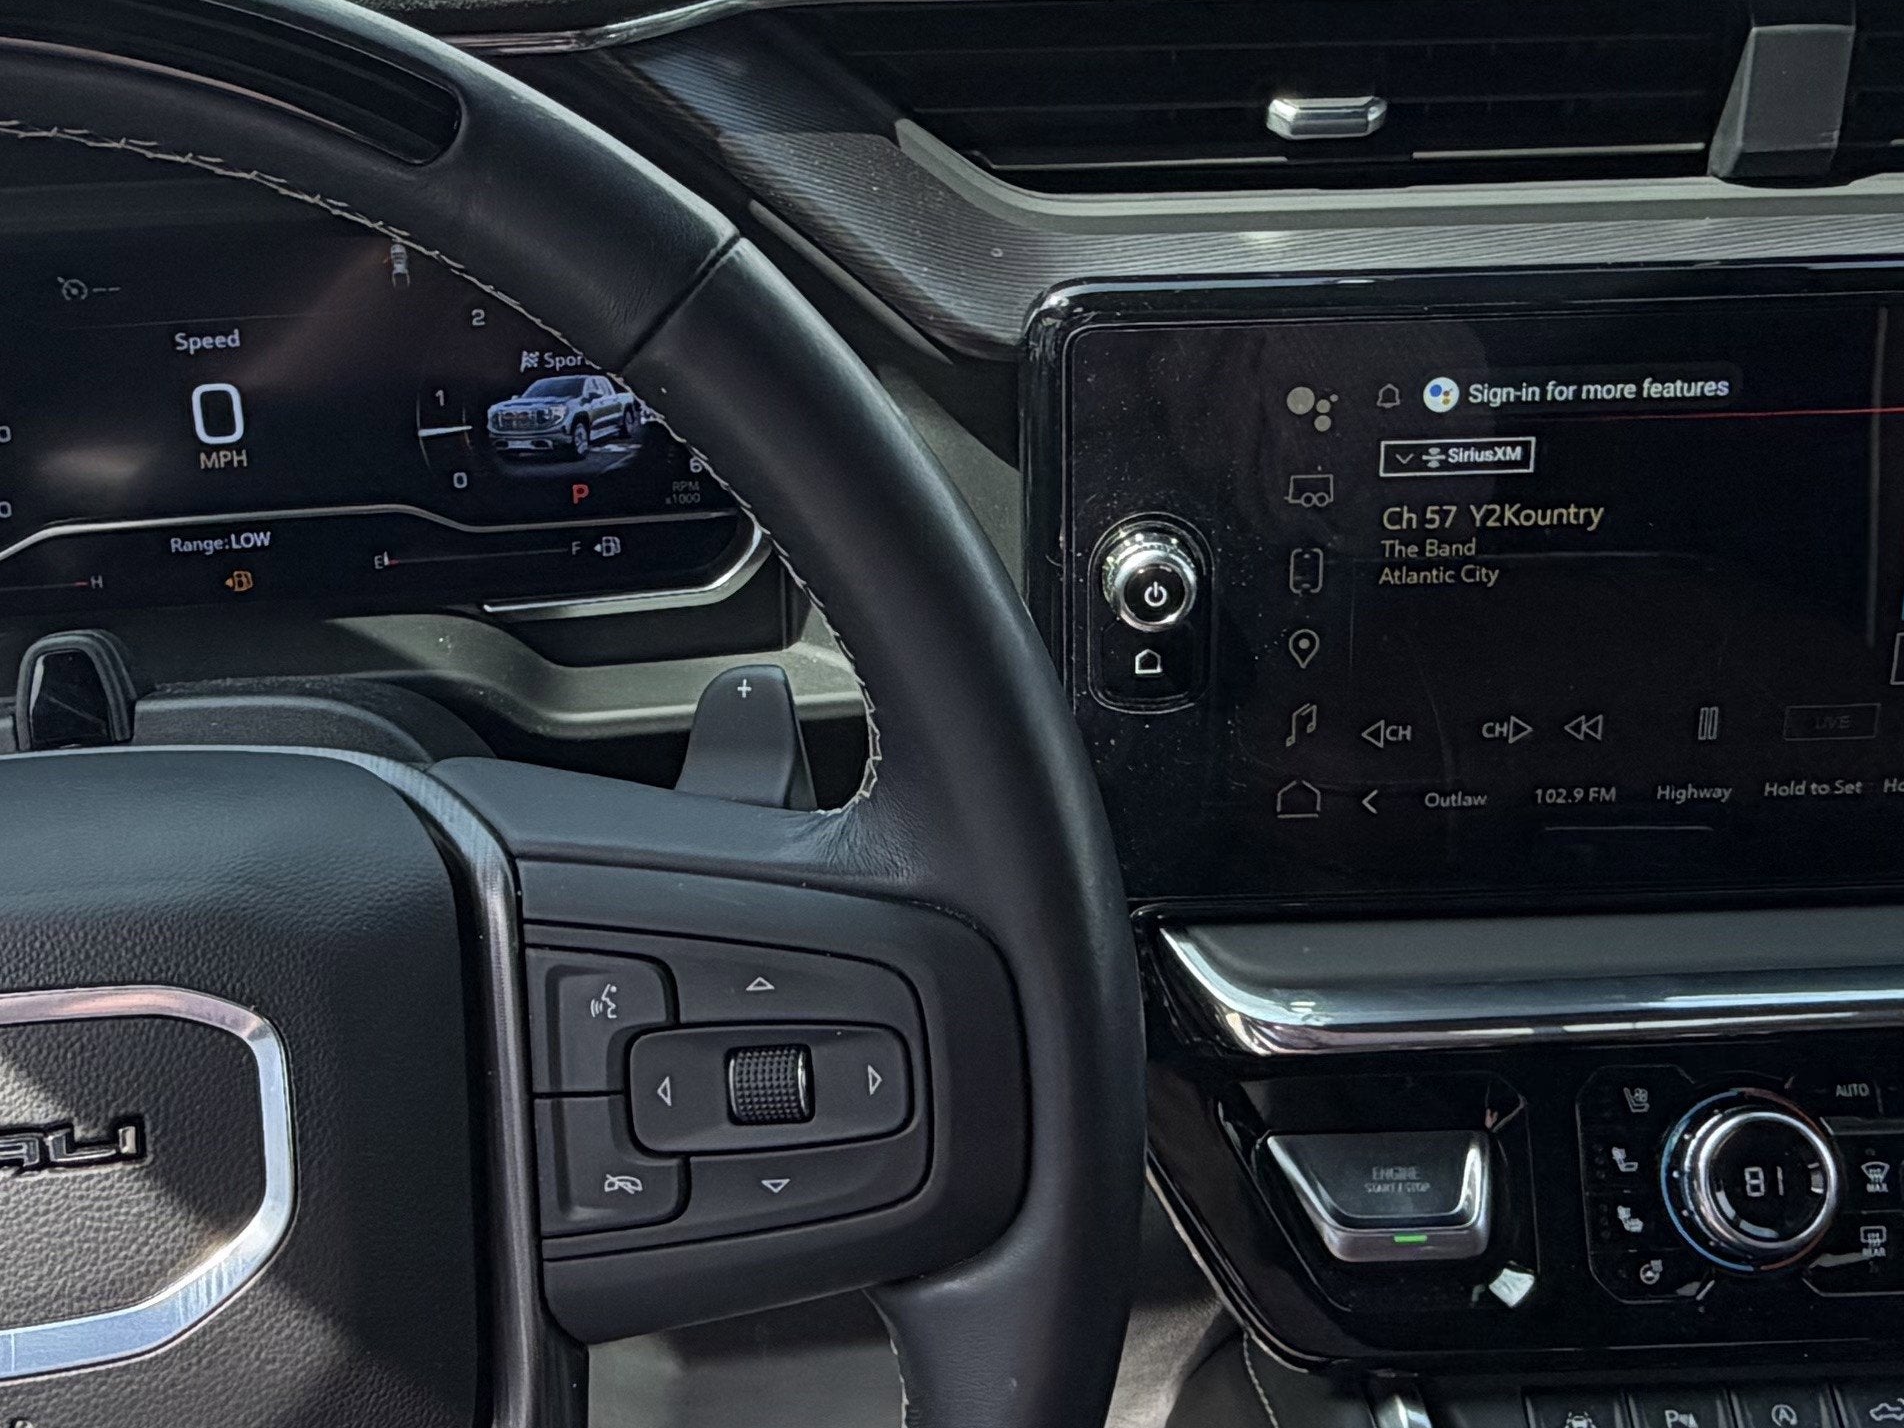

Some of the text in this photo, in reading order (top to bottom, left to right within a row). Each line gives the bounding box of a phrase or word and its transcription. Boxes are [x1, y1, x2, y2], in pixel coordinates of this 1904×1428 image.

[470, 308, 487, 329] 2
[175, 329, 240, 355] Speed
[543, 351, 584, 371] Spor
[434, 389, 446, 406] 1
[1468, 377, 1730, 407] Sign-in for more features
[191, 382, 245, 444] 0
[199, 450, 248, 470] MPH
[1447, 446, 1523, 465] SiriusXM
[452, 472, 468, 489] 0
[571, 483, 590, 504] P
[1382, 503, 1605, 532] Ch 57 Y2Kountry
[571, 541, 582, 557] F
[1381, 538, 1477, 560] The Band
[1379, 564, 1500, 587] Atlantic City
[1385, 724, 1412, 742] CH
[1481, 721, 1508, 739] CH
[1534, 786, 1617, 805] 102.9 FM
[1656, 784, 1733, 805] Highway
[1764, 779, 1864, 798] Hold to Set
[1424, 791, 1488, 808] Outlaw
[1835, 1083, 1870, 1098] AUTO
[1744, 1165, 1784, 1198] 81
